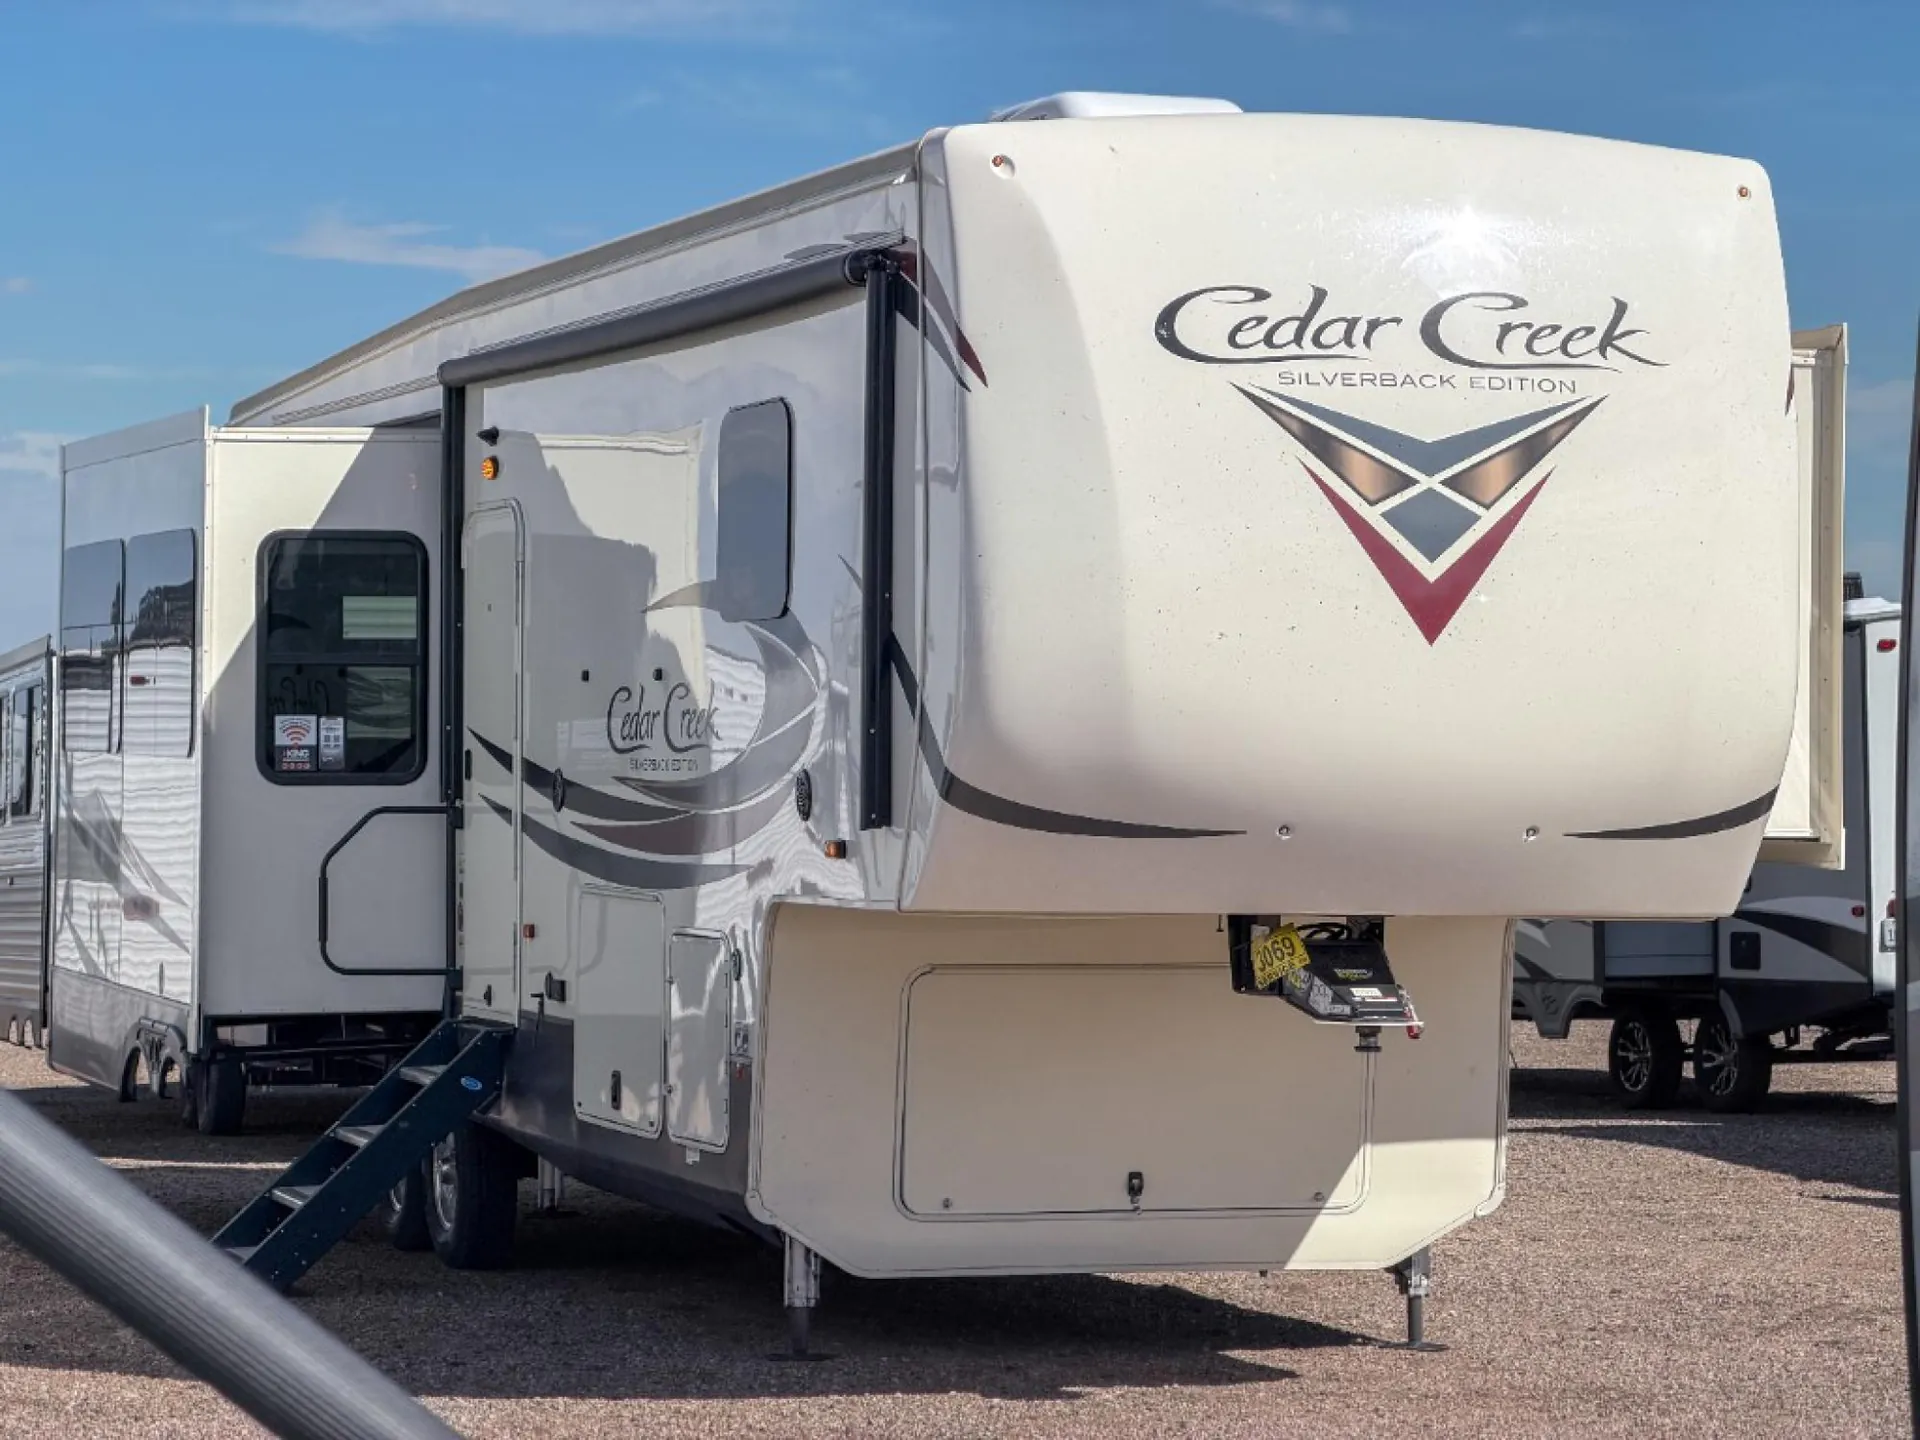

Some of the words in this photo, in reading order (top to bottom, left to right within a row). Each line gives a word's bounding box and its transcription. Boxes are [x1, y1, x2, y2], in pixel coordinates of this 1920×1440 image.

[1154, 284, 1402, 363] Cedar
[1419, 292, 1669, 371] Creek
[1277, 369, 1456, 391] SILVERBACK
[1469, 376, 1577, 395] EDITION
[607, 683, 660, 754] Cedar
[664, 678, 723, 753] Creek
